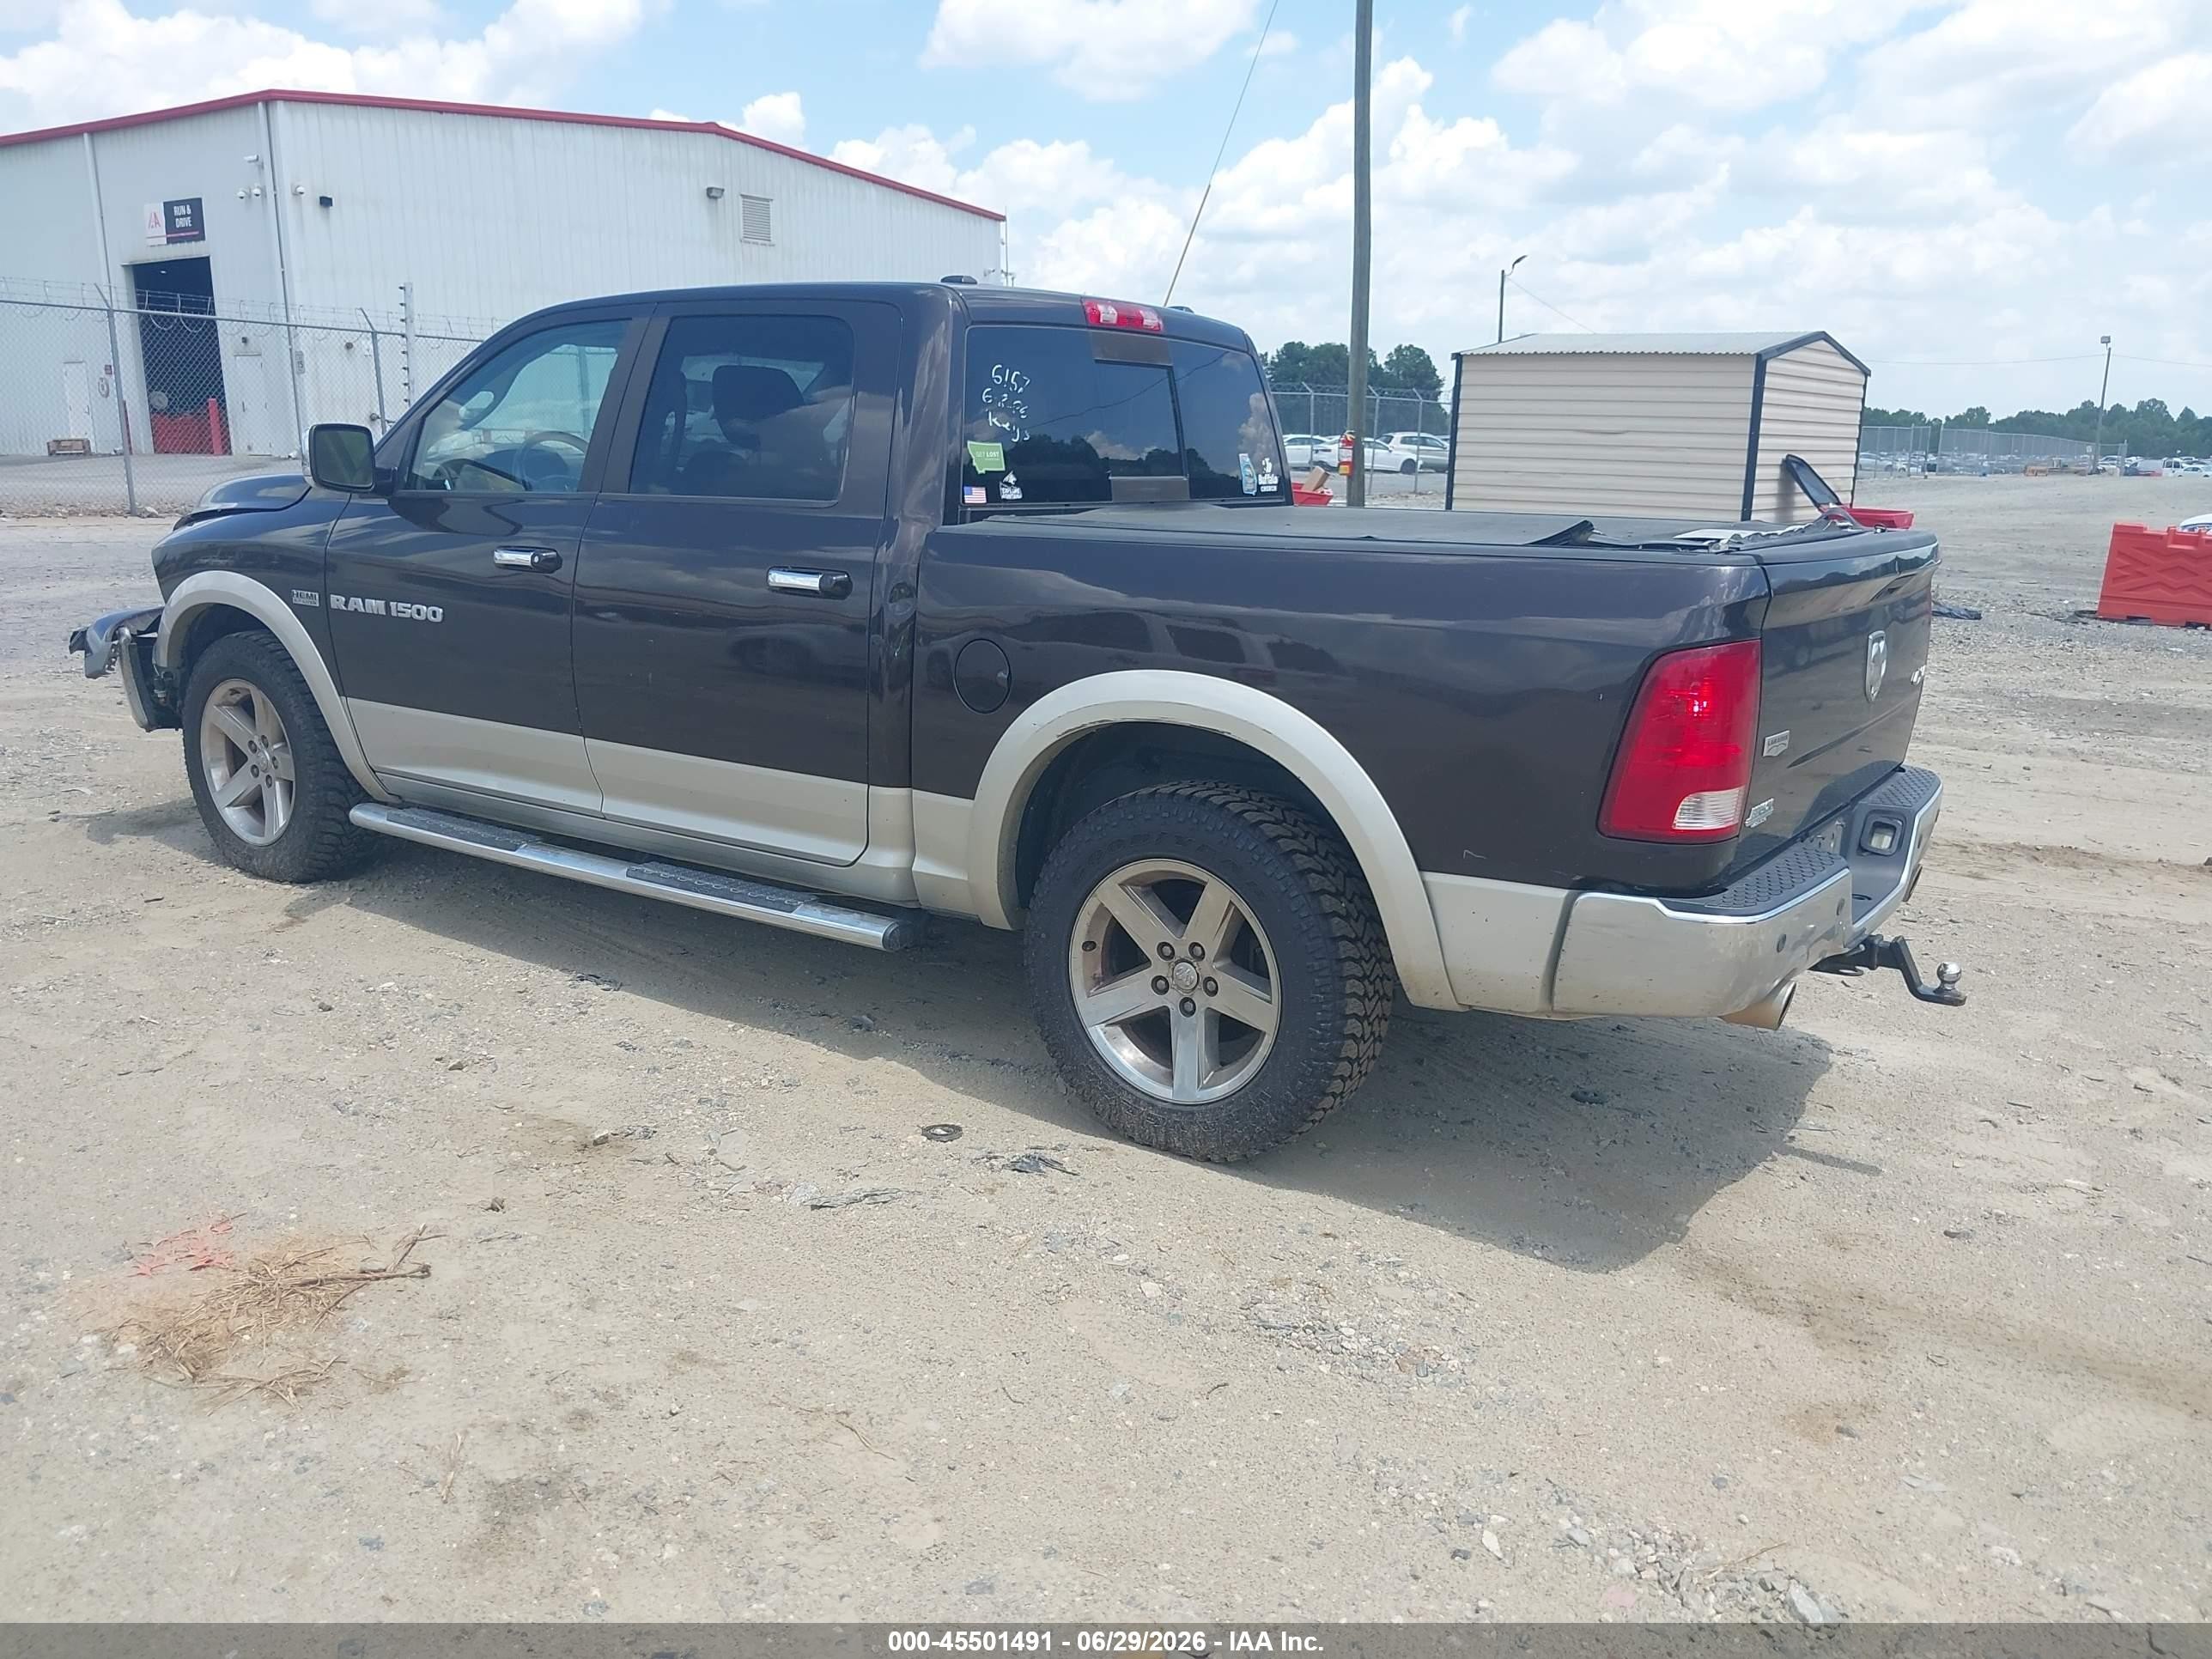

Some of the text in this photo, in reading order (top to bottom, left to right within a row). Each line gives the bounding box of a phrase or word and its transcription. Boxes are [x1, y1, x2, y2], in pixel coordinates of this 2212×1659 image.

[173, 204, 192, 216] RUN &
[175, 217, 192, 228] DRIVE
[291, 590, 318, 601] HEMI
[330, 594, 444, 623] RAM 1500
